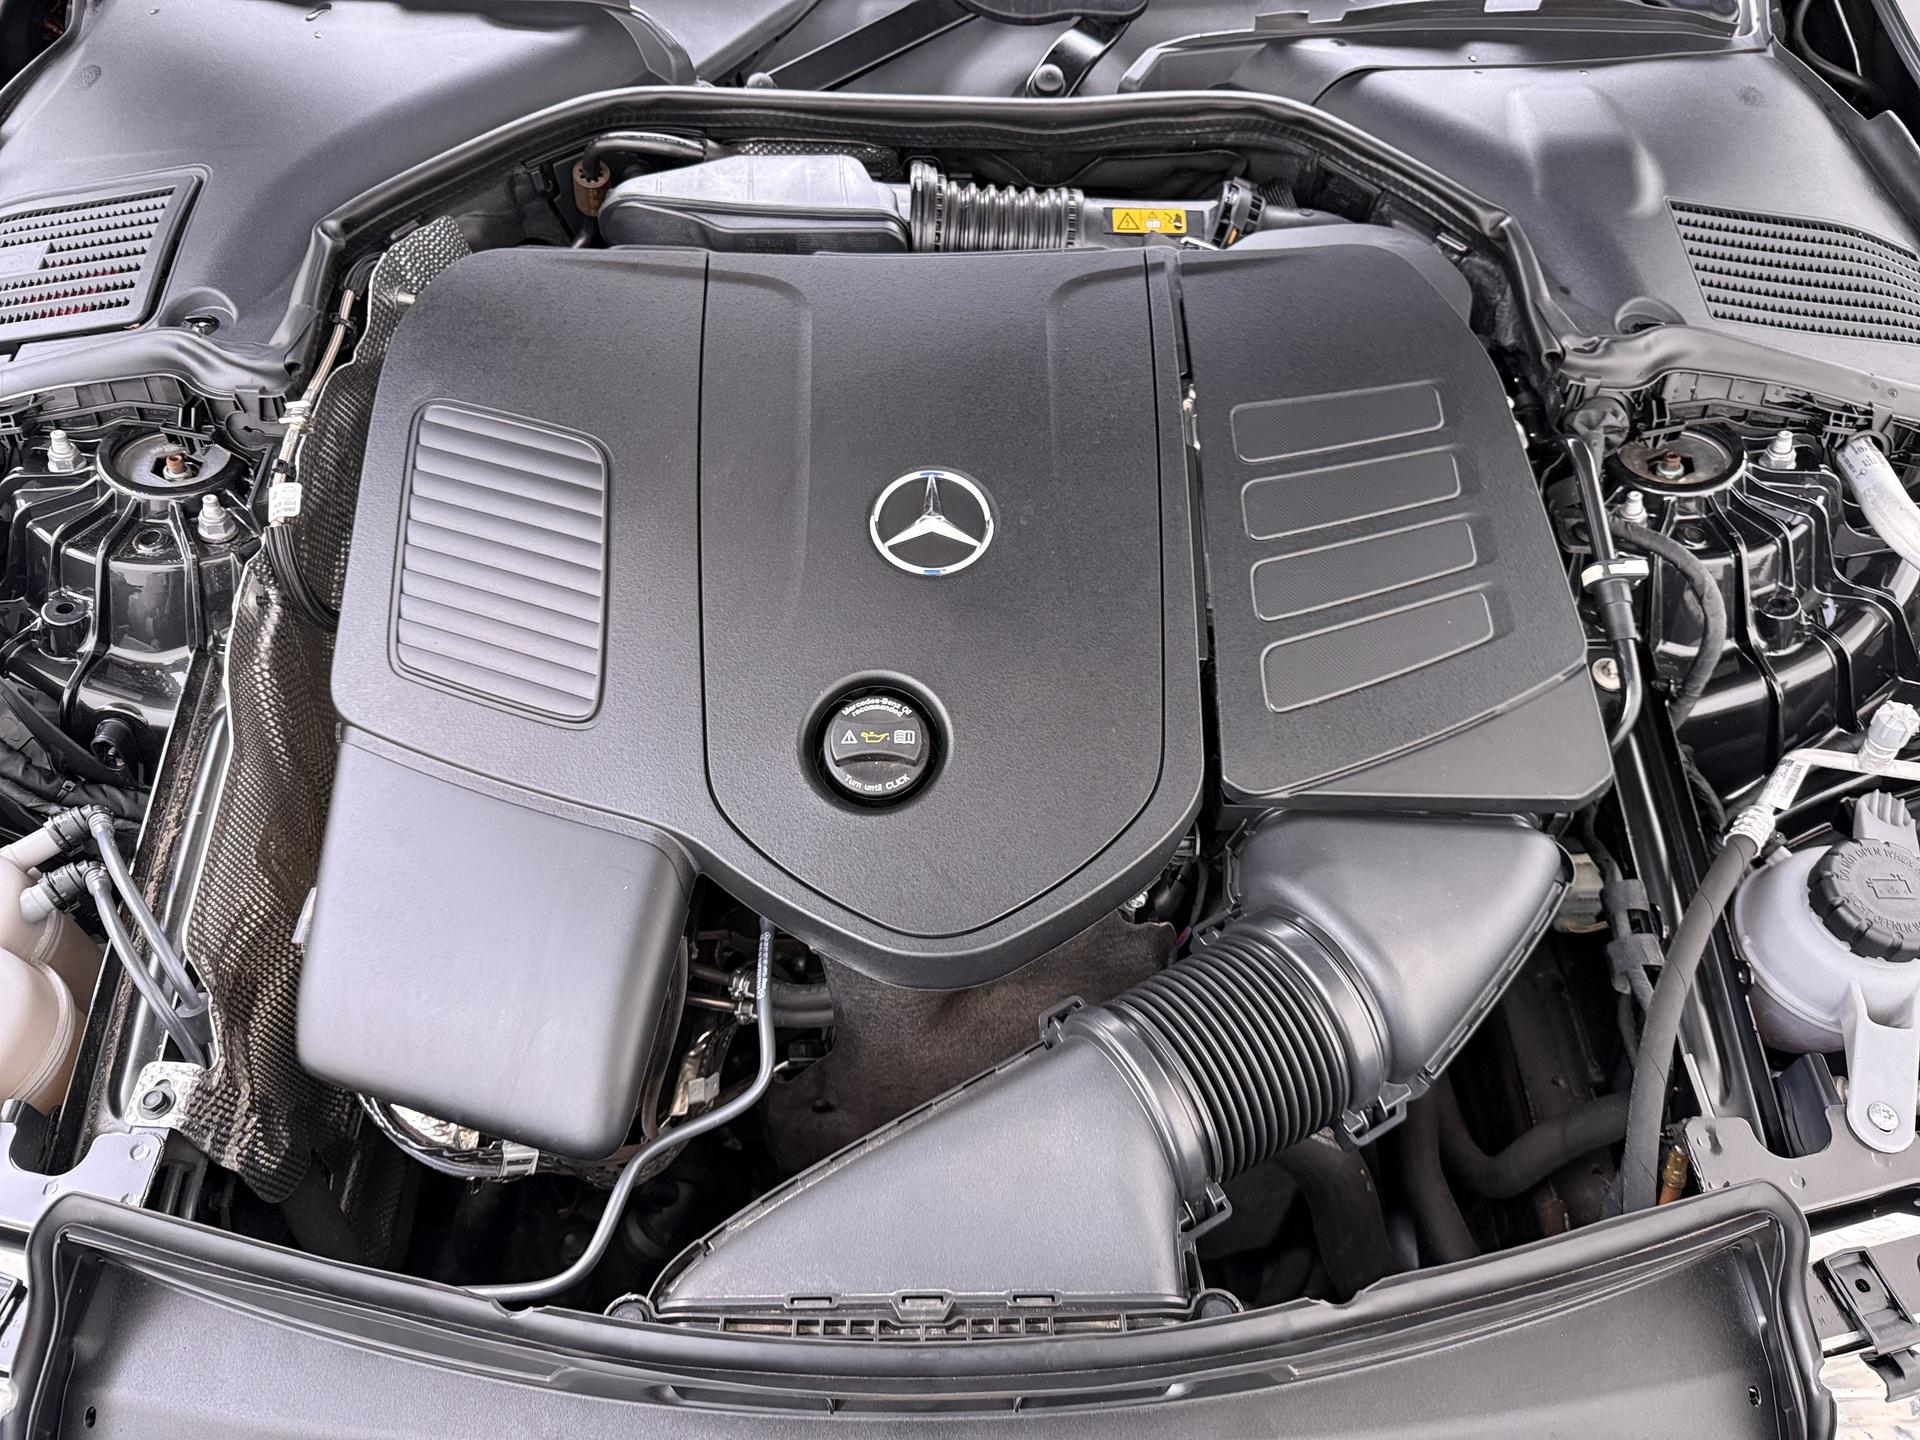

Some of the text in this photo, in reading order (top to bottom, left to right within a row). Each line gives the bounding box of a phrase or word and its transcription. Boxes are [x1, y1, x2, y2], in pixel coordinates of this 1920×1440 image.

[841, 697, 913, 716] Mercedes-Benz Oil
[851, 704, 904, 718] recommended
[844, 774, 911, 792] Turn until CLICK
[1856, 847, 1881, 859] OPEN
[1842, 855, 1856, 870] NOT
[1840, 869, 1850, 881] DO
